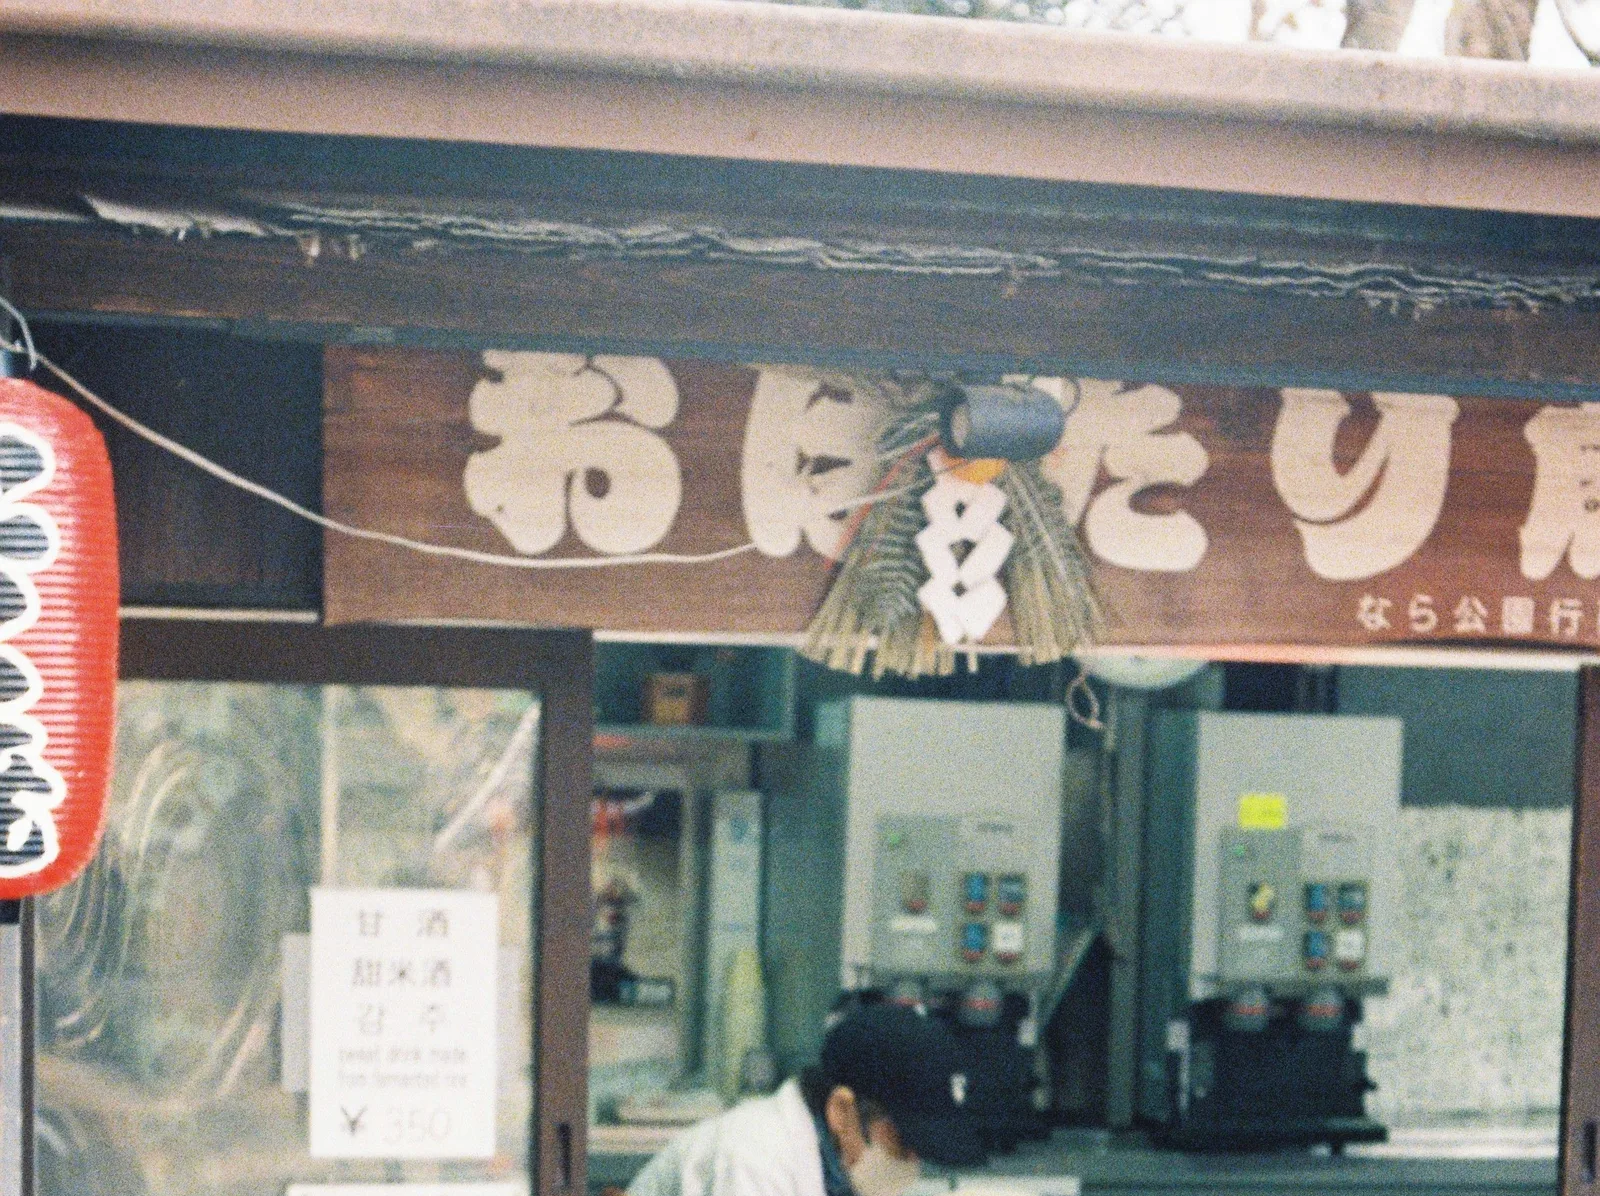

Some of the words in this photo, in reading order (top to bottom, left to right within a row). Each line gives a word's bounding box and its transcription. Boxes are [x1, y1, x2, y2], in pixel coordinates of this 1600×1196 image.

[1356, 593, 1600, 639] なら公園行
